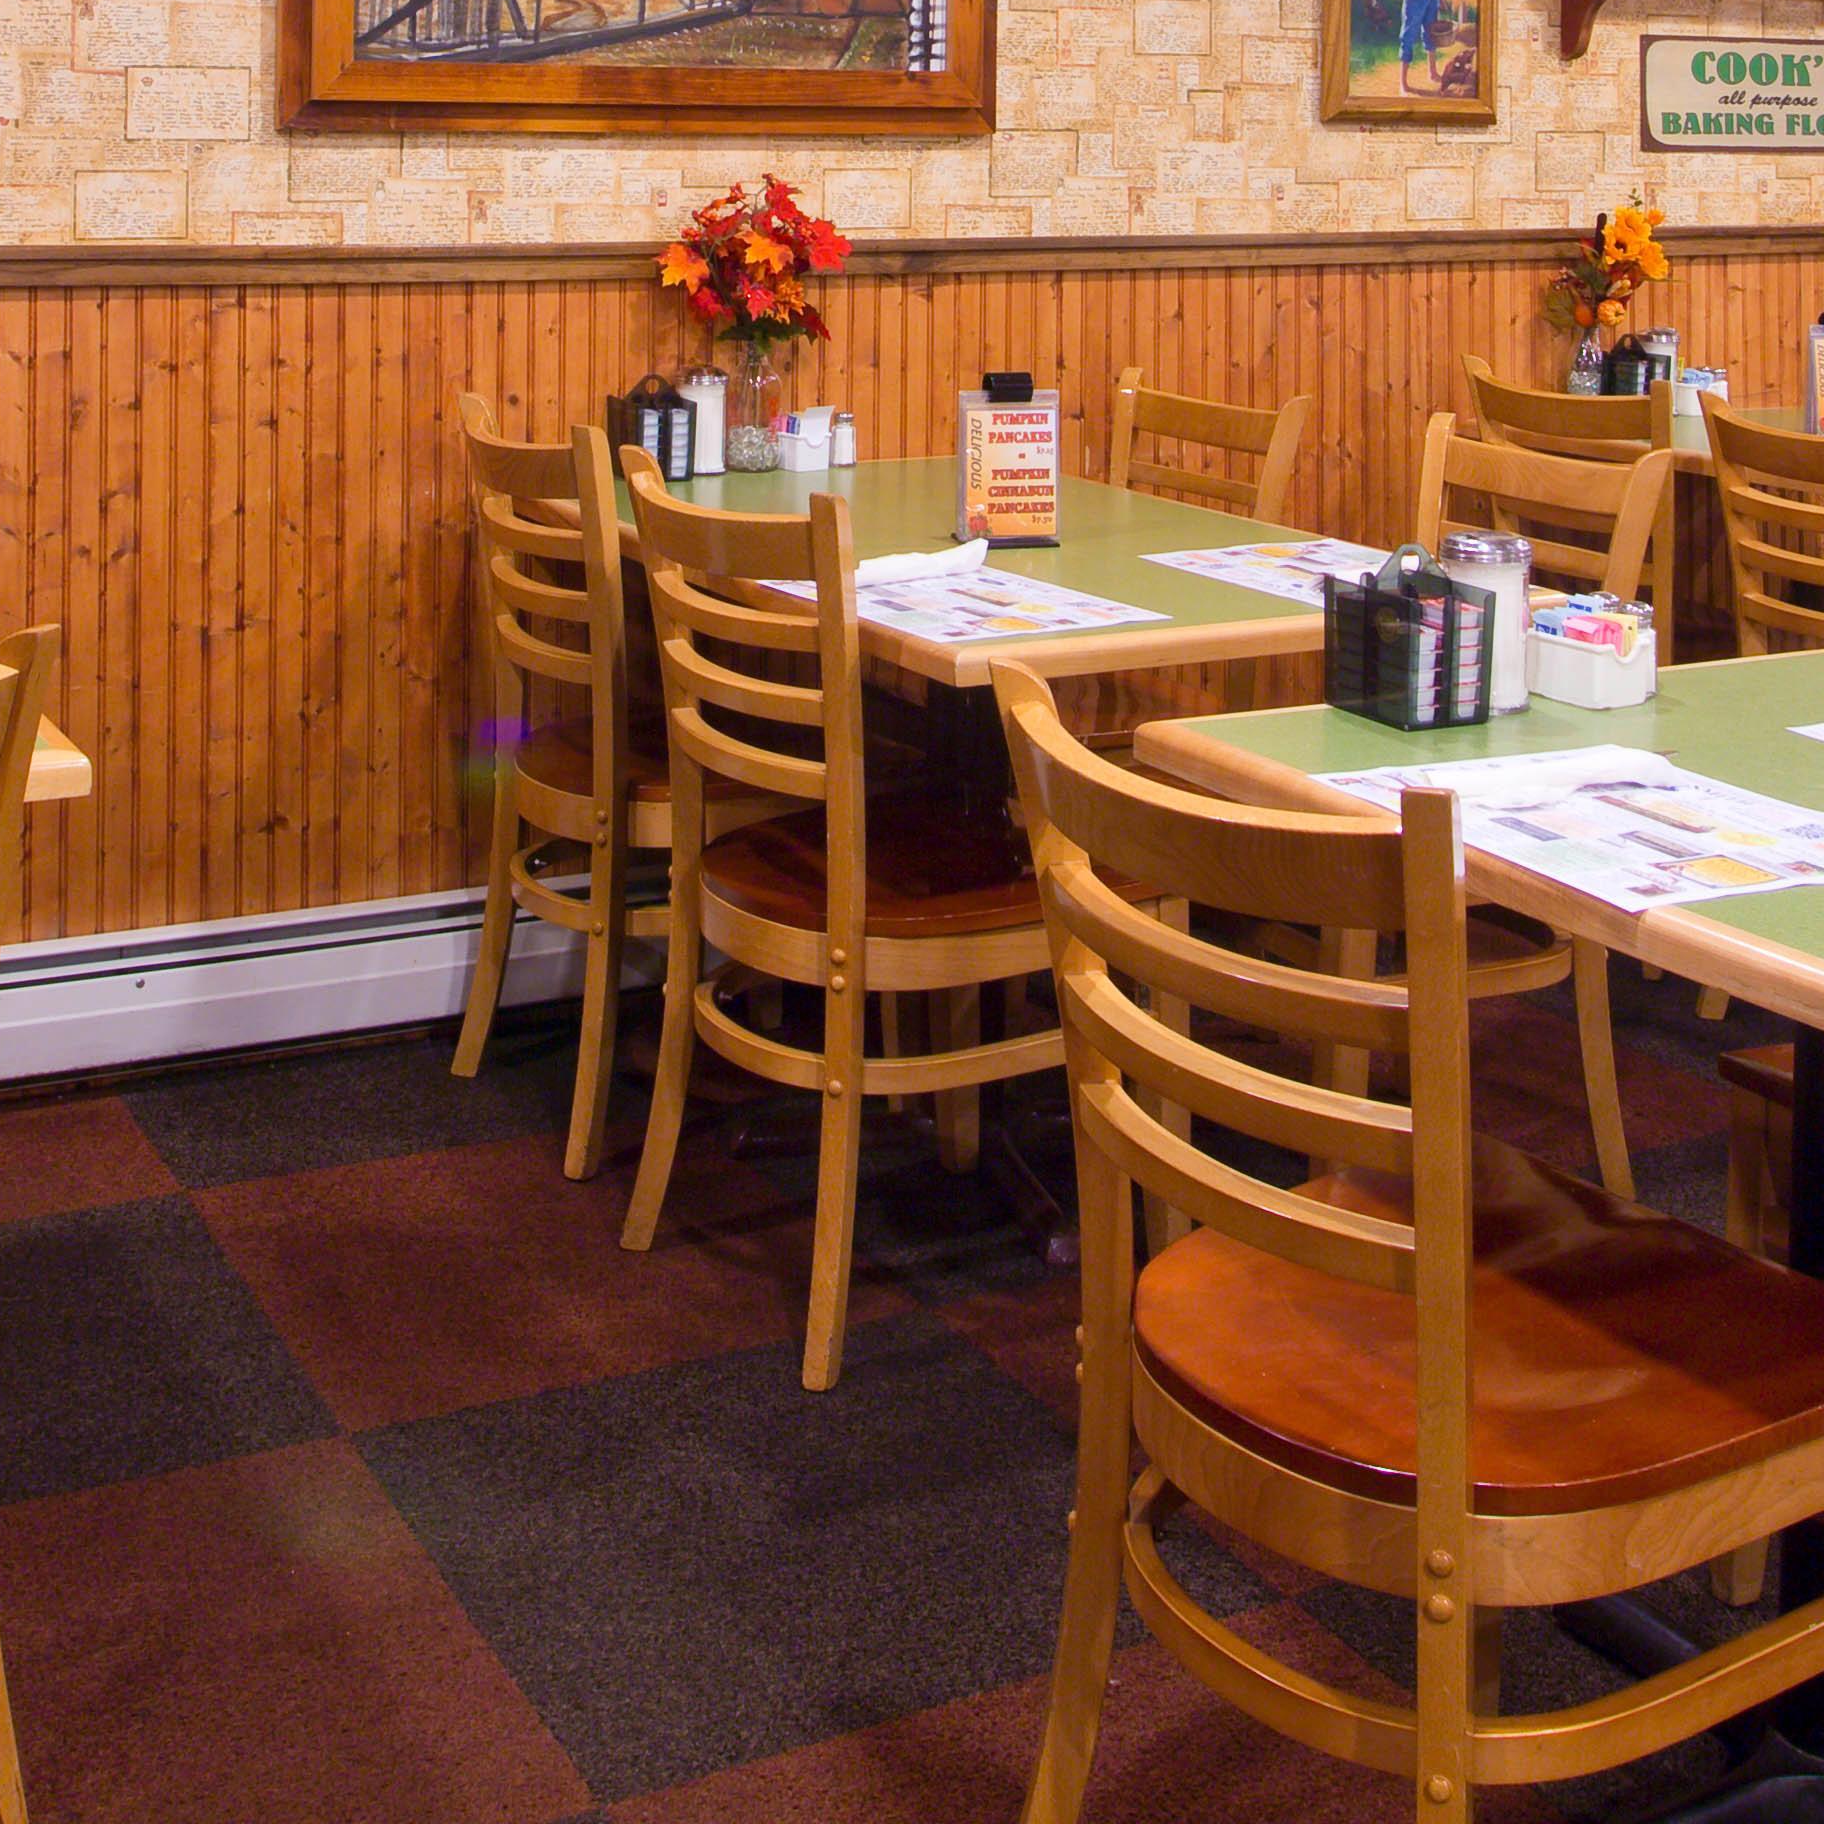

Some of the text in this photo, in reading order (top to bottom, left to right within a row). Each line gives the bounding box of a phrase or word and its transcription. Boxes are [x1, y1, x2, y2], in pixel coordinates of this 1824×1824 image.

[1718, 90, 1819, 110] all purpose
[1661, 111, 1775, 136] BAKING
[992, 414, 1048, 425] PUMPKIN
[988, 432, 1052, 443] PANCAKES
[971, 418, 982, 490] DELICIOUS
[992, 469, 1049, 480] PUMPKIN
[988, 502, 1054, 514] PANCAKES
